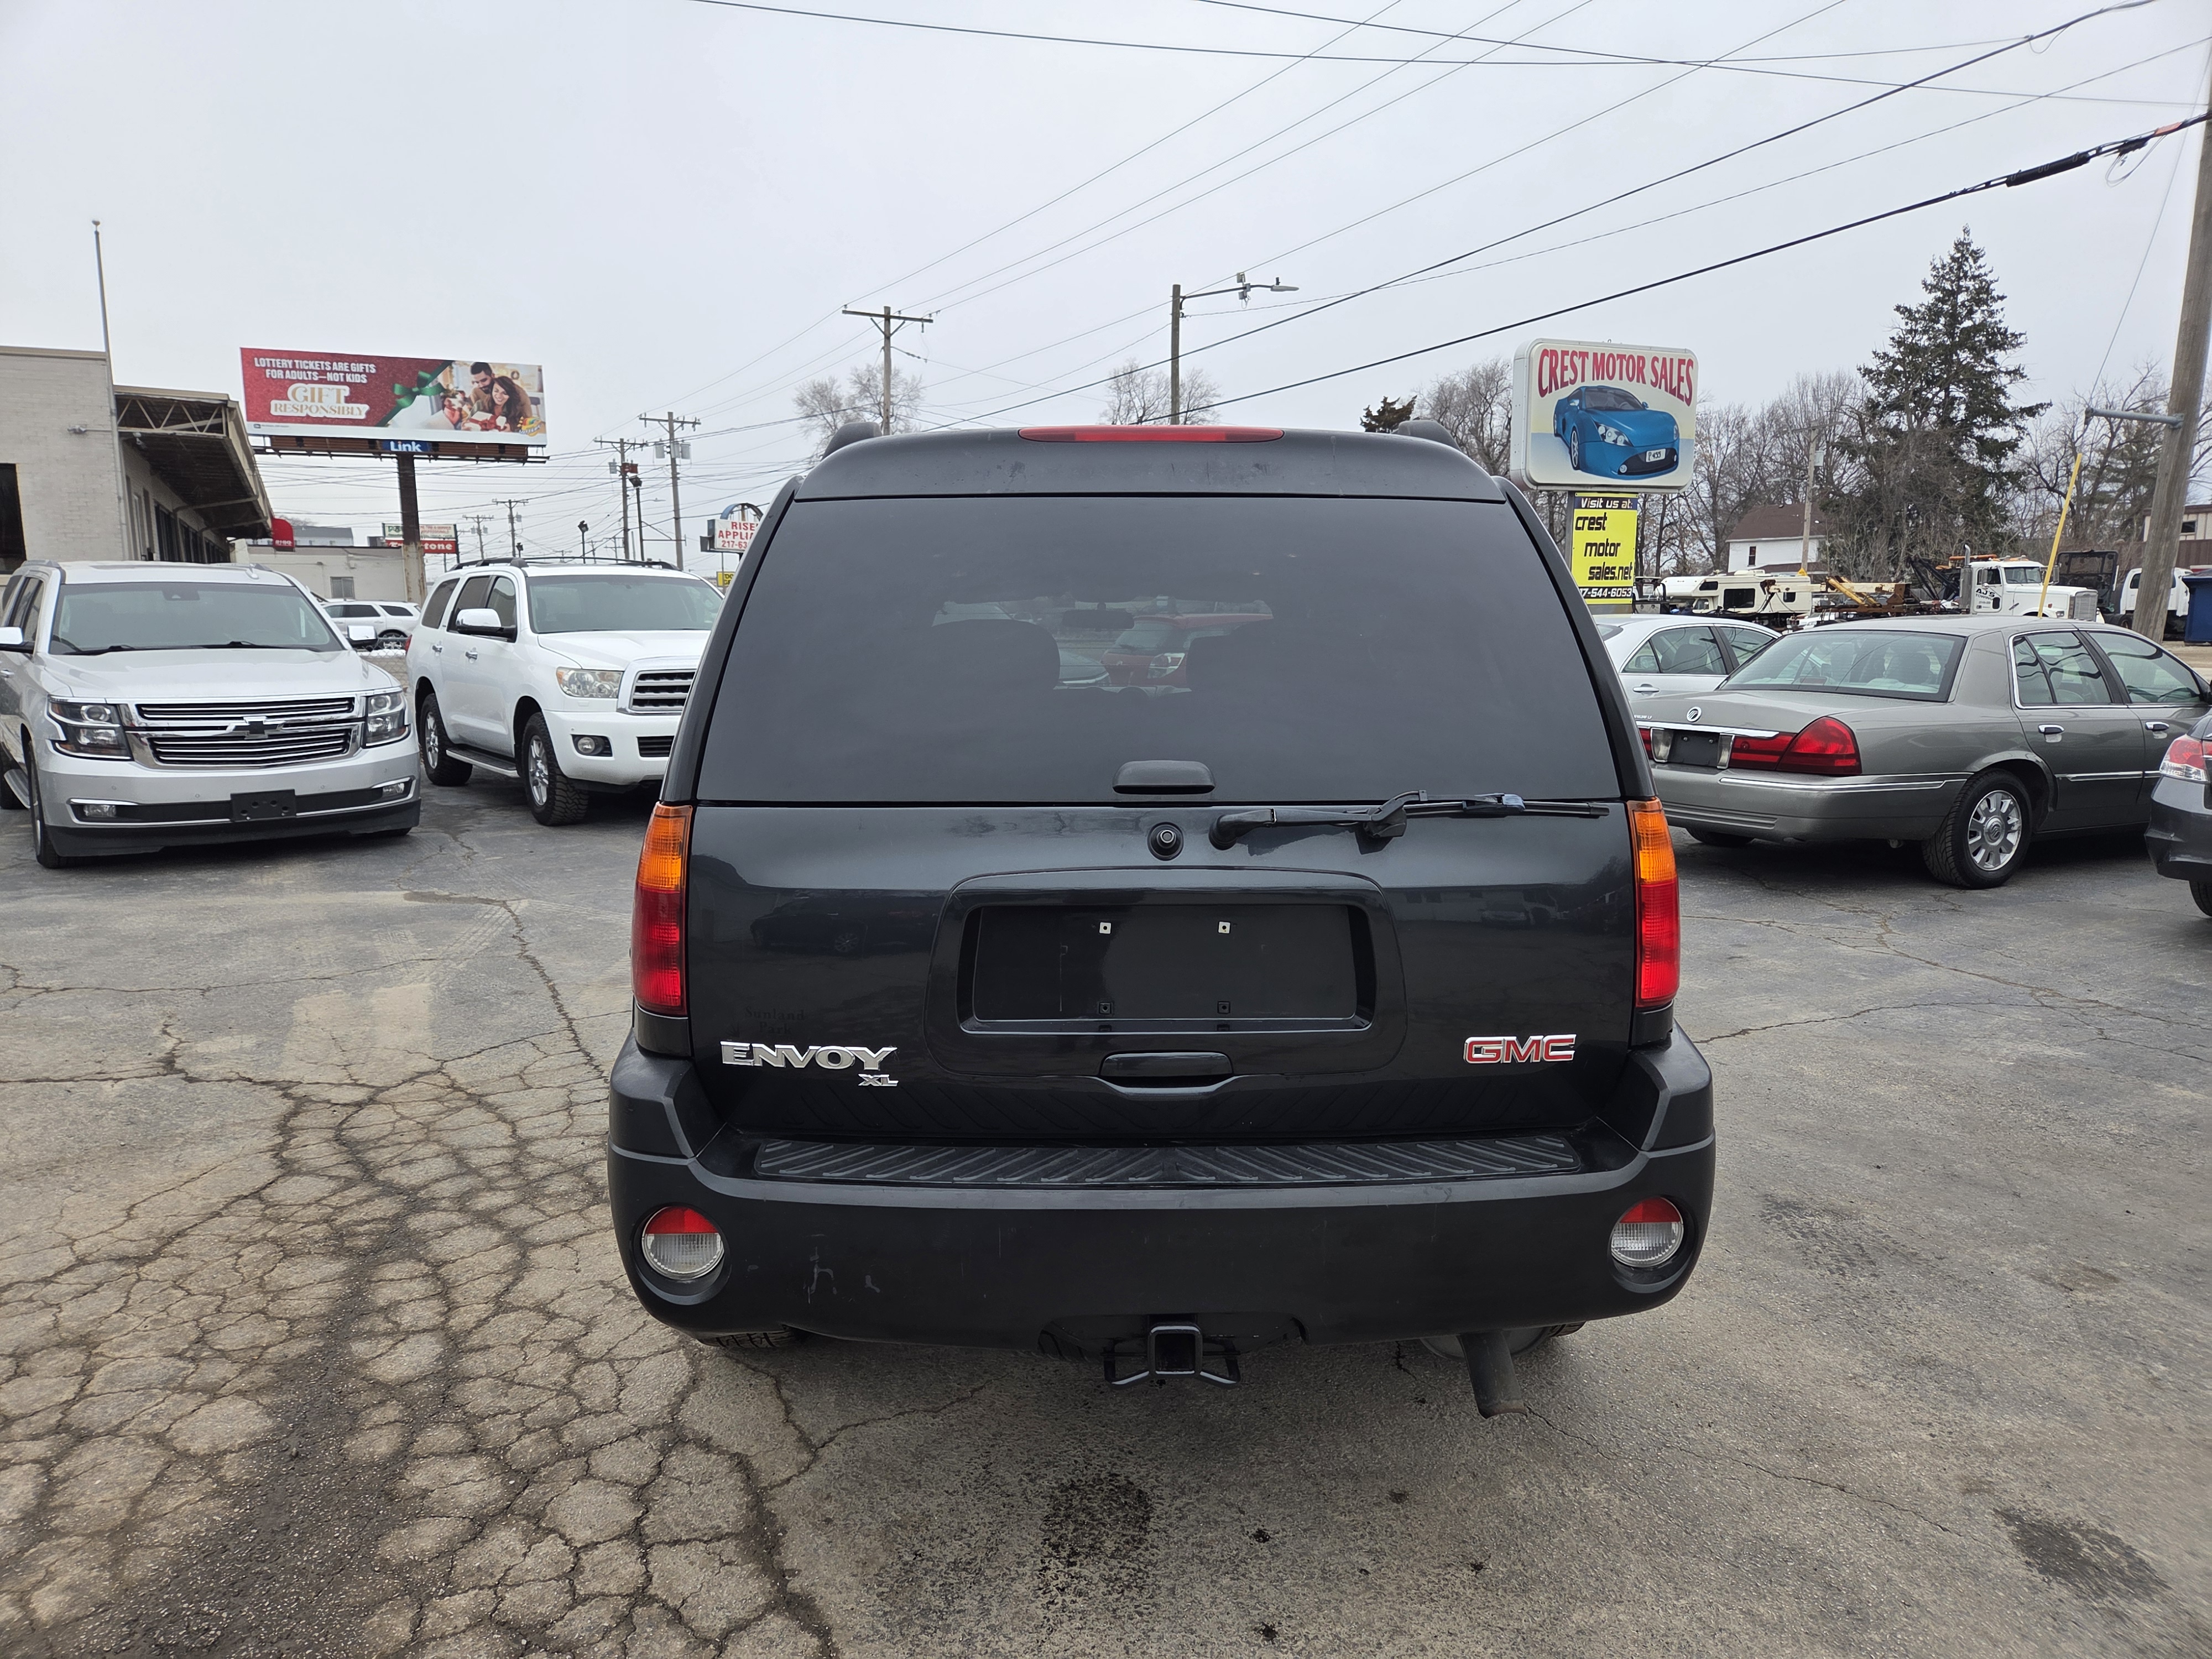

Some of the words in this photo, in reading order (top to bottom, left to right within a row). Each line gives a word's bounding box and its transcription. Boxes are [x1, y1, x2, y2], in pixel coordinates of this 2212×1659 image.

[254, 358, 293, 368] LOTTERY
[294, 360, 331, 371] TICKETS
[332, 362, 349, 372] ARE
[351, 363, 377, 373] GIFTS
[265, 369, 284, 379] FOR
[346, 373, 368, 383] KIDS
[1538, 348, 1589, 398] CREST
[1592, 352, 1646, 384] MOTOR
[1650, 356, 1694, 406] SALES
[291, 386, 346, 404] GIFT
[274, 403, 366, 416] RESPONSIBLY
[390, 441, 422, 452] Link
[1581, 498, 1603, 508] Visit
[1605, 500, 1619, 508] us
[1575, 512, 1608, 531] crest
[1584, 538, 1621, 557] motor
[1588, 562, 1633, 581] sales.net
[745, 1005, 806, 1021] Sunland
[759, 1021, 792, 1035] Park
[720, 1041, 898, 1071] ENVOY
[1463, 1034, 1576, 1064] GMC
[858, 1073, 899, 1087] XL
